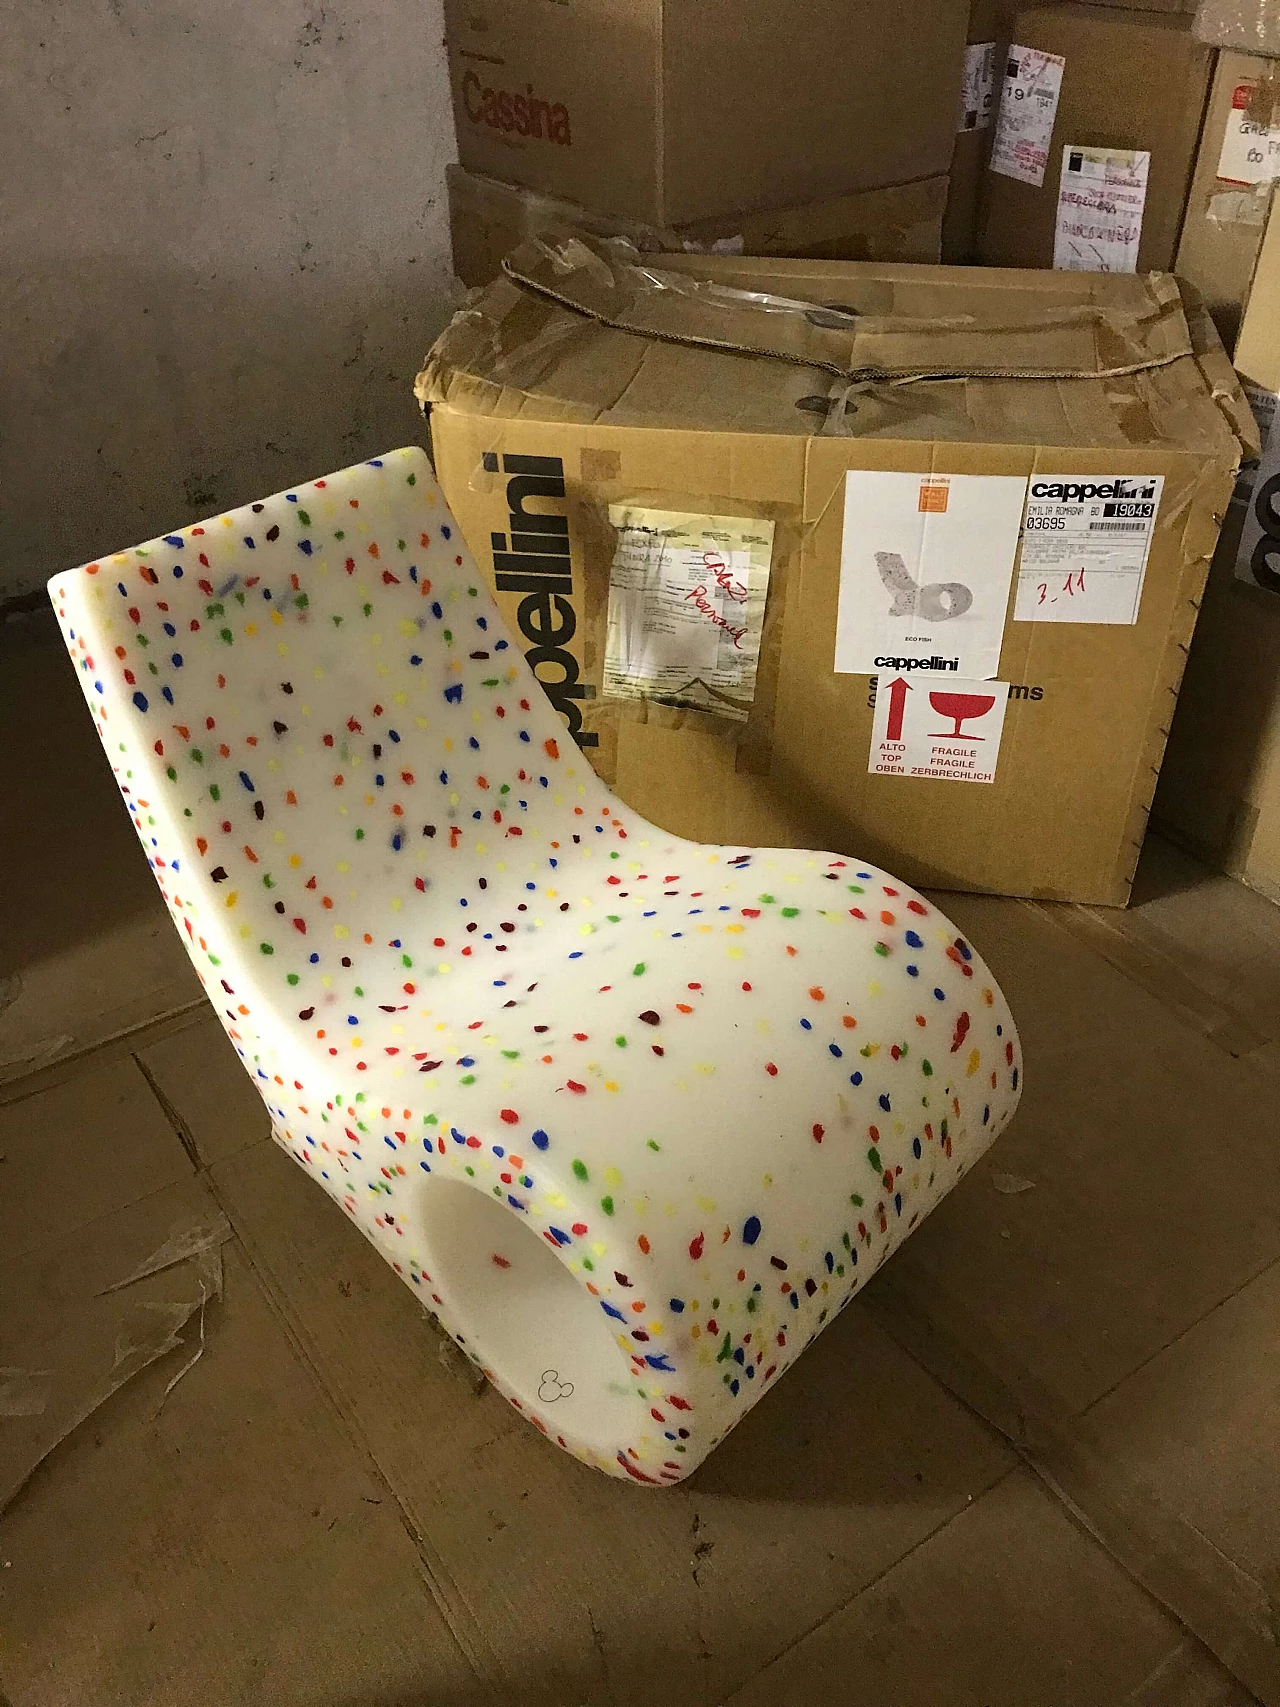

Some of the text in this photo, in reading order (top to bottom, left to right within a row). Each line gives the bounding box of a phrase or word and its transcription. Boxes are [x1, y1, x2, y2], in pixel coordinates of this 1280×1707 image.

[462, 70, 571, 146] Cassina
[1028, 505, 1053, 516] EMILIA
[1056, 506, 1085, 516] ROMAGNA
[1112, 504, 1153, 517] 19043
[1026, 517, 1066, 530] 03695
[873, 655, 959, 672] cappellini
[879, 743, 906, 753] ALTO
[931, 746, 978, 758] FRAGILE
[881, 753, 903, 764] TOP
[930, 757, 976, 769] FRAGILE
[876, 764, 905, 775] OBEN
[911, 766, 992, 781] ZERBRECHLICH
